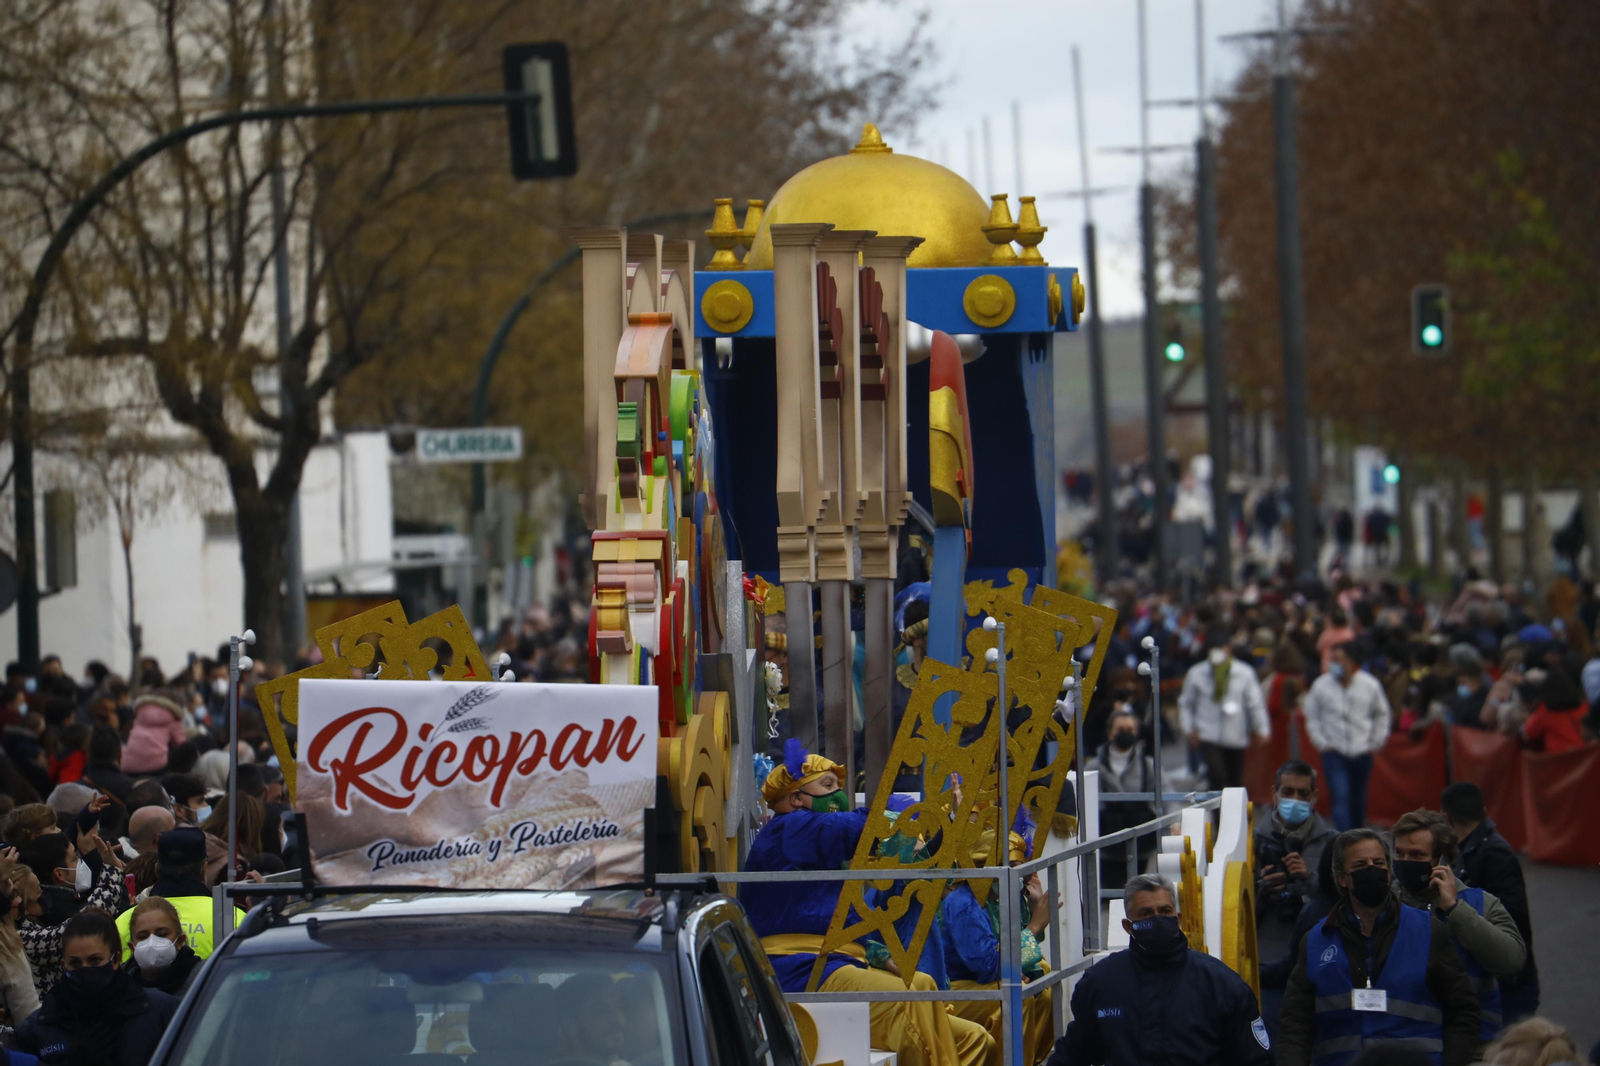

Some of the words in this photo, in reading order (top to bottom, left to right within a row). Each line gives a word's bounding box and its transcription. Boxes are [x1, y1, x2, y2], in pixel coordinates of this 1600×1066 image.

[307, 707, 646, 811] Ricopan
[367, 838, 481, 872] Panadería
[488, 839, 502, 862] y
[509, 818, 620, 854] Pastelería
